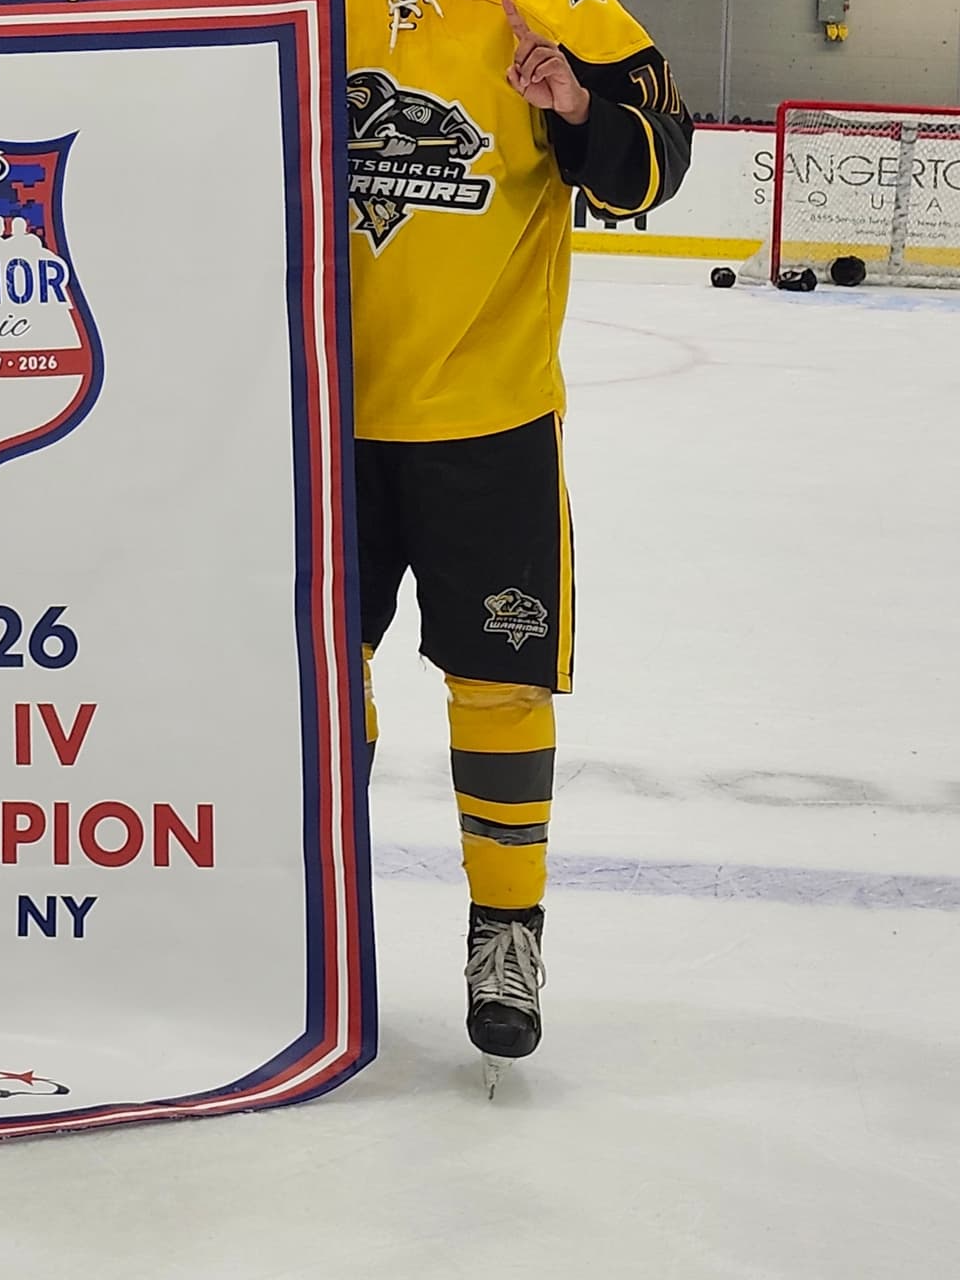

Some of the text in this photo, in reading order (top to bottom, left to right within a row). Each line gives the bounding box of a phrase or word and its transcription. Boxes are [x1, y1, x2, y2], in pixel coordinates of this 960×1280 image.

[348, 174, 483, 204] RRIORS
[18, 356, 58, 371] 2026
[14, 703, 98, 766] IV
[17, 894, 98, 938] NY
